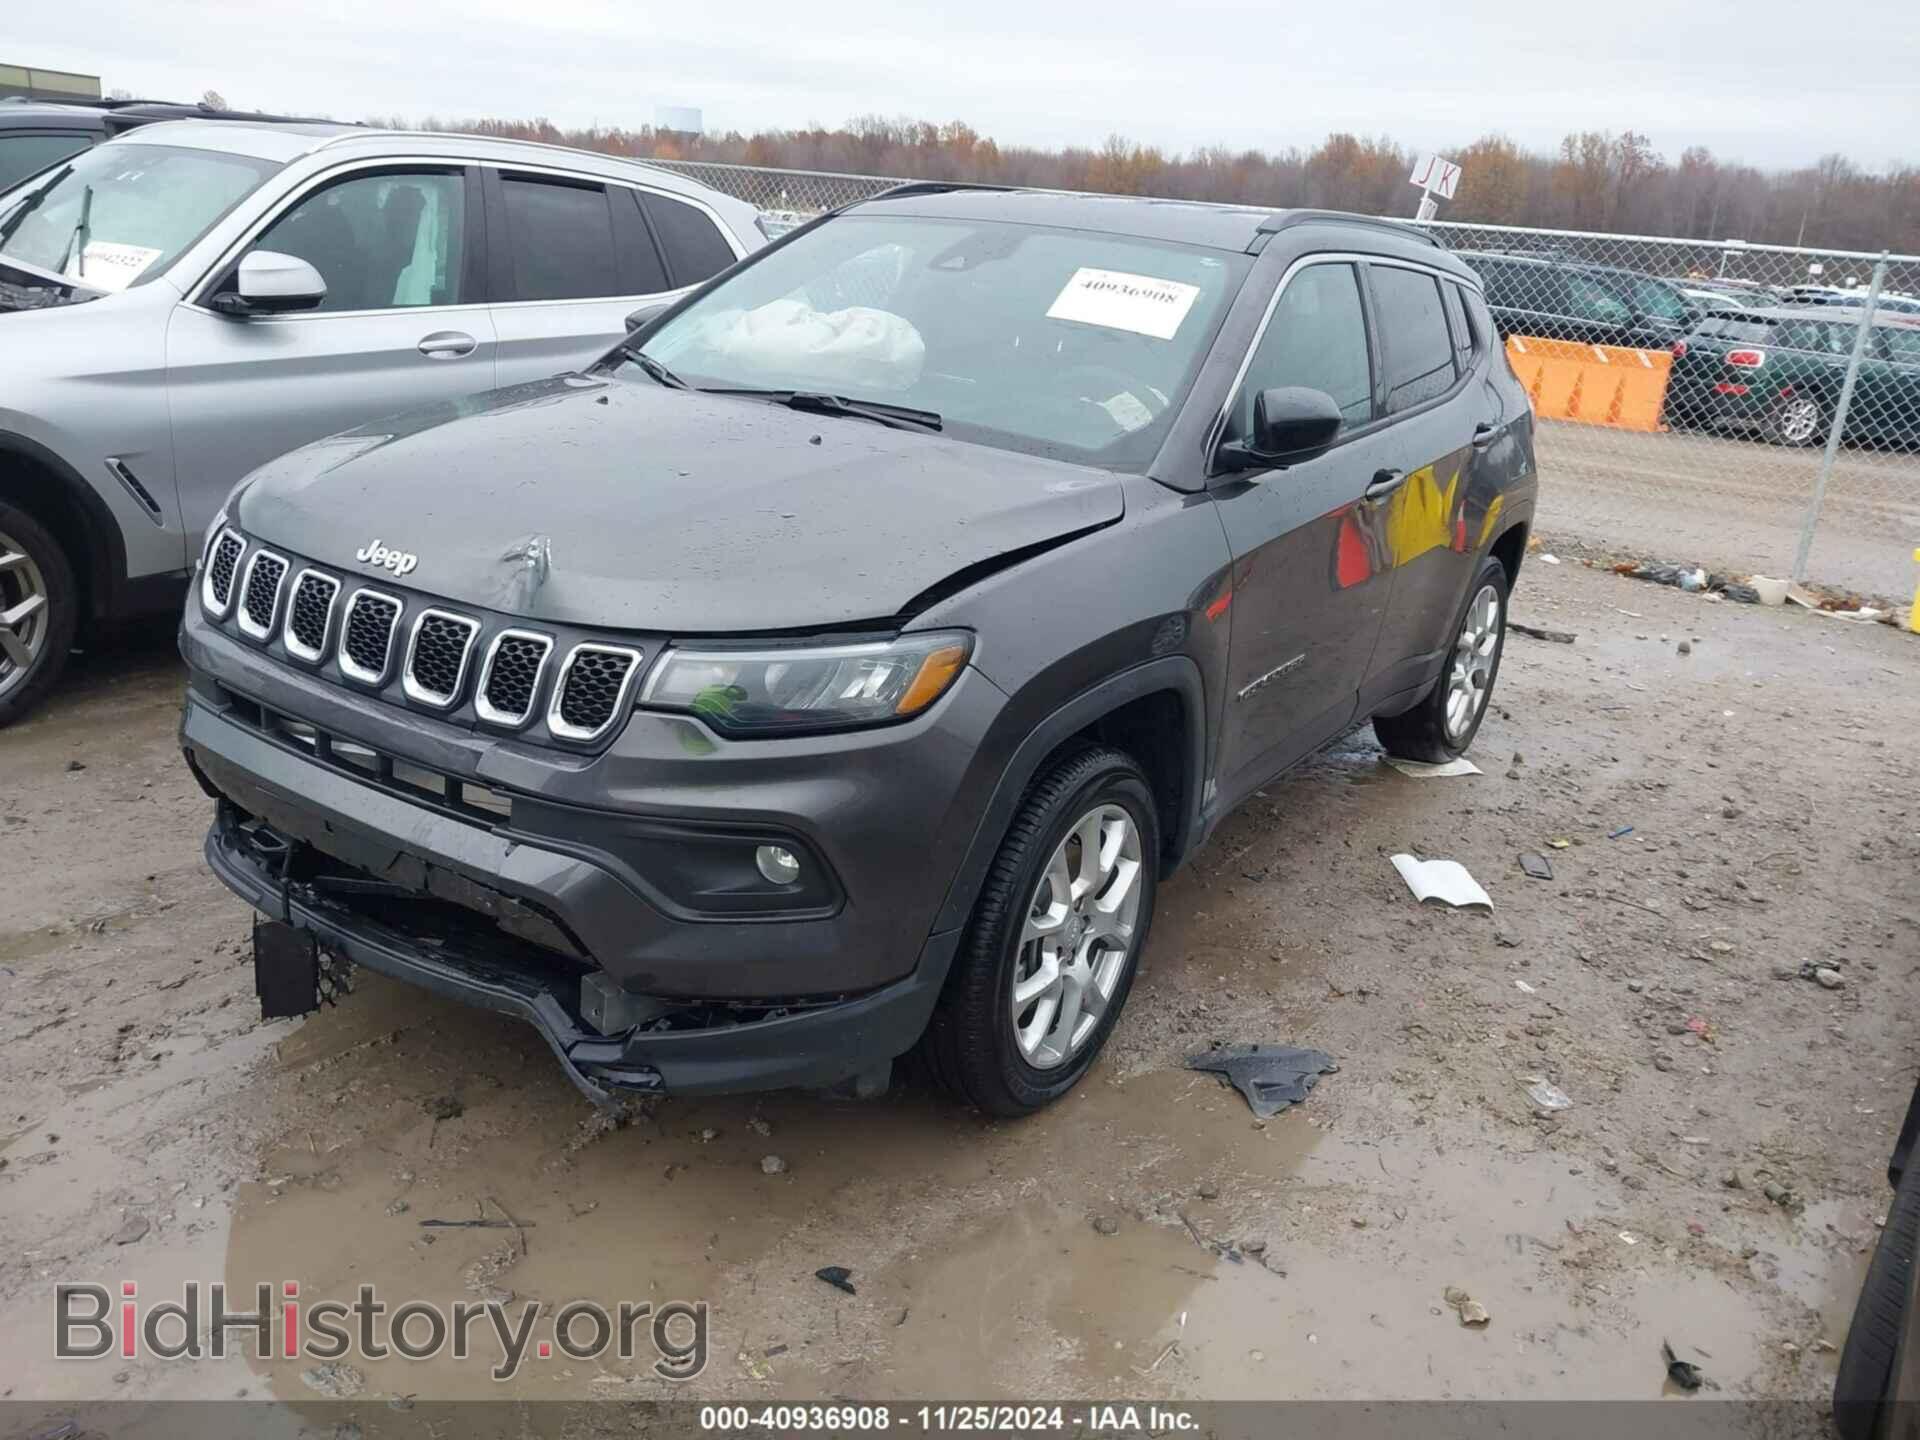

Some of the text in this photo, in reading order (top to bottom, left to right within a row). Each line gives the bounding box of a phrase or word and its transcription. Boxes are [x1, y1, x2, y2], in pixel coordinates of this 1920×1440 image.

[1438, 163, 1457, 195] K
[1080, 279, 1179, 303] 40936908
[356, 539, 417, 577] Jeep
